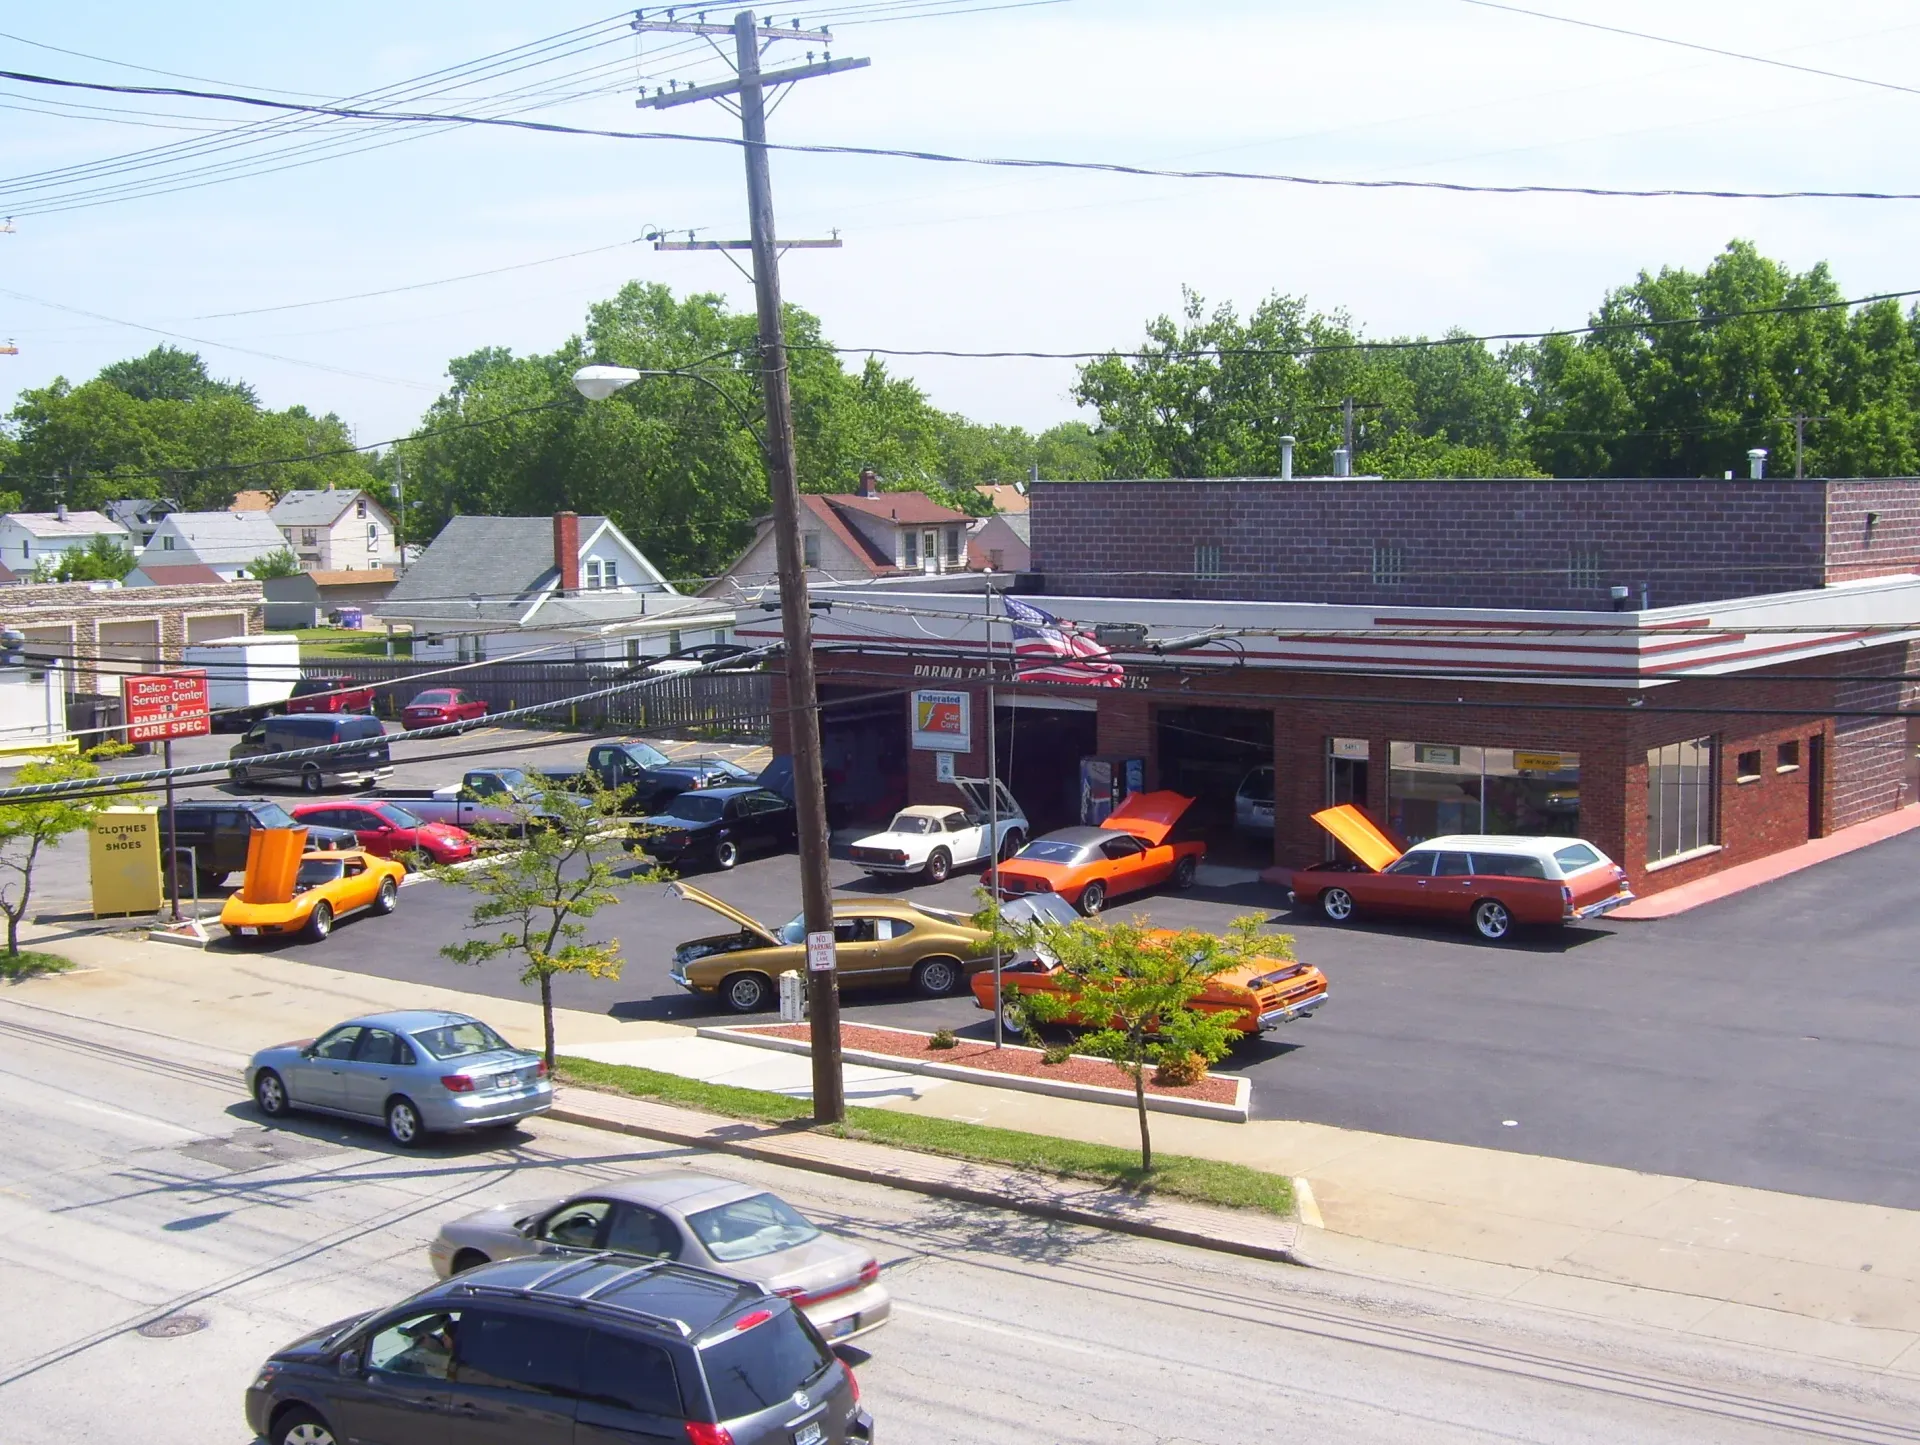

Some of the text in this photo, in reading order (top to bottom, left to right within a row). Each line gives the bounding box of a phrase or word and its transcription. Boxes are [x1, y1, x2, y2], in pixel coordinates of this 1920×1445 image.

[913, 664, 962, 679] PARMA
[138, 682, 167, 694] Delco
[173, 679, 196, 690] Tech
[132, 691, 204, 706] Service Center
[917, 694, 960, 703] Federated
[944, 712, 960, 721] Car
[134, 720, 206, 738] CARE SPEC.
[940, 720, 960, 730] Care
[97, 824, 147, 834] CLOTHES
[105, 841, 142, 851] SHOES
[815, 935, 826, 943] NO
[810, 943, 833, 951] PARKING
